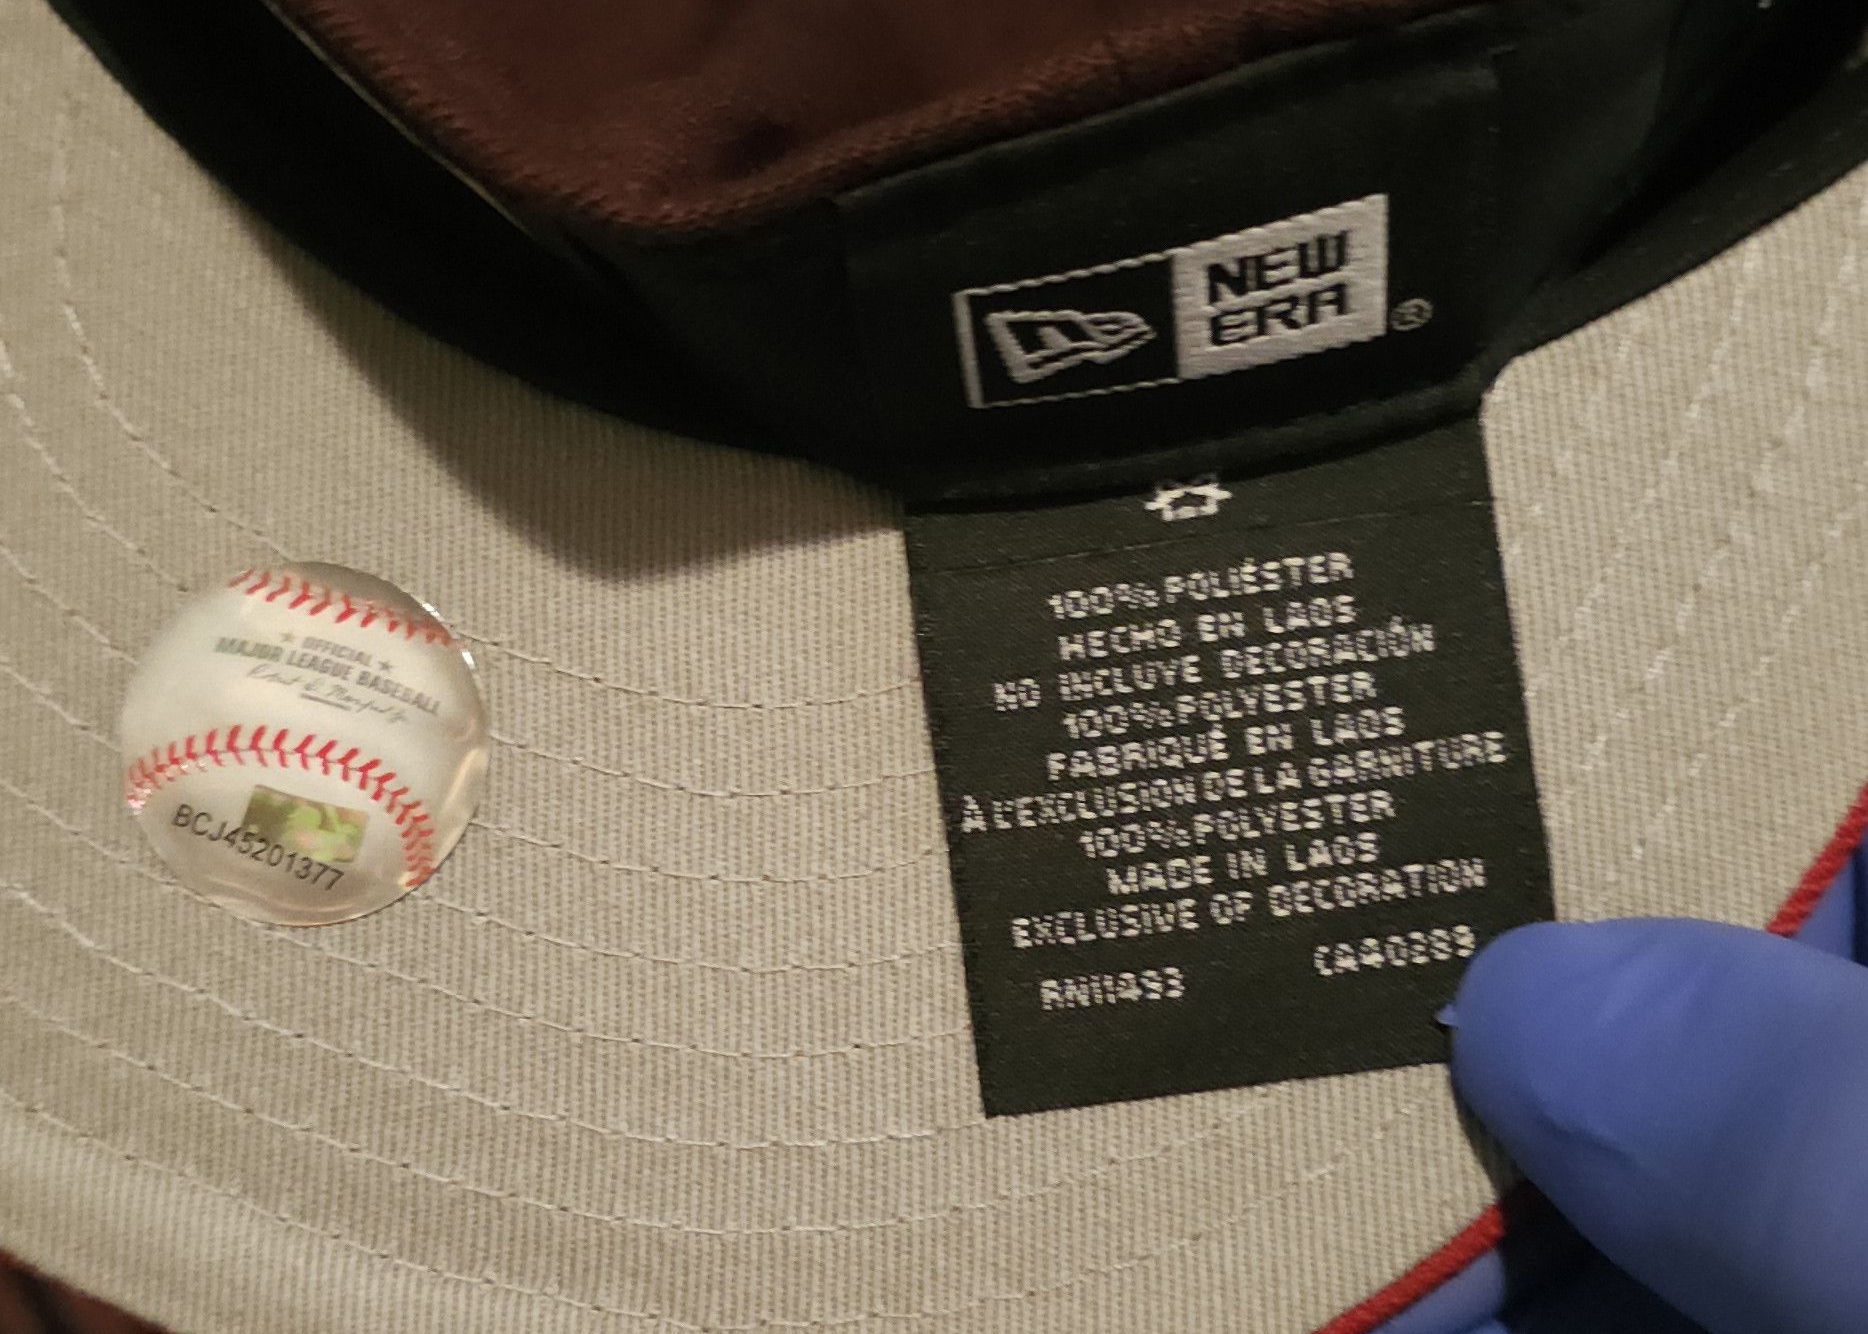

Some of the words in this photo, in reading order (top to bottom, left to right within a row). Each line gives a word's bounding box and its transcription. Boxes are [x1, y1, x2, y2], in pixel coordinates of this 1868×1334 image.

[1207, 230, 1347, 305] NEW
[1210, 283, 1348, 347] ERA
[301, 636, 372, 667] OFFICIAL
[1058, 619, 1182, 661] HECHO
[1198, 612, 1247, 643] EN
[1263, 595, 1358, 634] LAOS
[215, 636, 284, 661] MAJOR
[286, 649, 353, 681] LEAGUE
[356, 670, 441, 715] BASEBALL
[993, 678, 1041, 711] NO
[1058, 655, 1203, 702] INCLUYE
[1047, 723, 1230, 781] FABRIQUÉ
[1246, 723, 1294, 756] EN
[1310, 706, 1406, 746] LAOS
[1204, 768, 1248, 802] DE
[1254, 762, 1302, 794] LA
[1307, 731, 1506, 788] GARNITURE
[171, 803, 345, 892] BCJ45201377
[1106, 855, 1215, 895] MADE
[1226, 848, 1268, 880] IN
[1284, 832, 1380, 872] LAOS
[1011, 898, 1200, 949] EXCLUSIVE
[1210, 891, 1253, 925] OF
[1268, 858, 1488, 917] DECORATION
